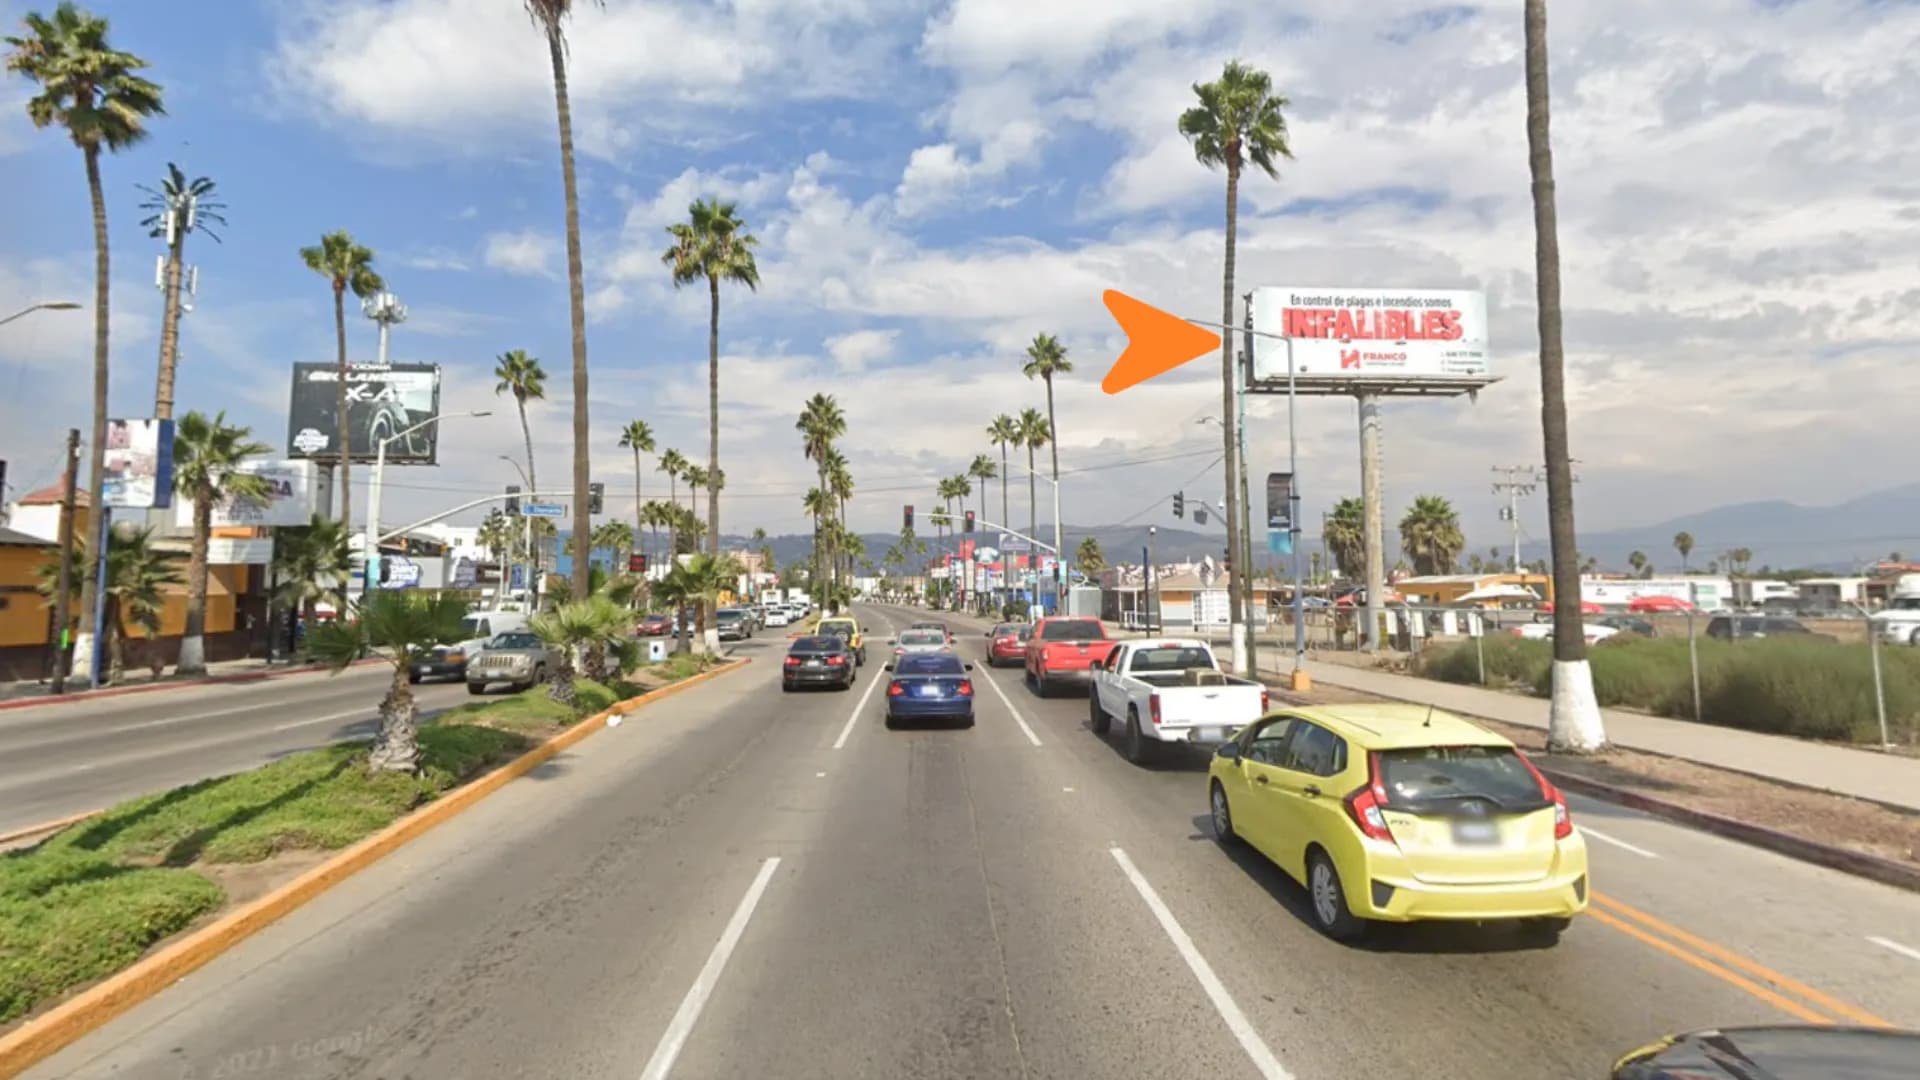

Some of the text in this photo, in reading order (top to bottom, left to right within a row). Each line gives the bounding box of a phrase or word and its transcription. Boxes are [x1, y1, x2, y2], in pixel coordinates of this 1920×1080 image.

[1290, 294, 1301, 305] En
[1303, 295, 1332, 306] control
[1335, 296, 1345, 307] de
[1347, 296, 1374, 309] plagas
[1383, 295, 1422, 307] incendios
[1424, 299, 1451, 308] somos
[1282, 308, 1463, 340] INFALIBLES
[1363, 352, 1407, 361] FRANCO
